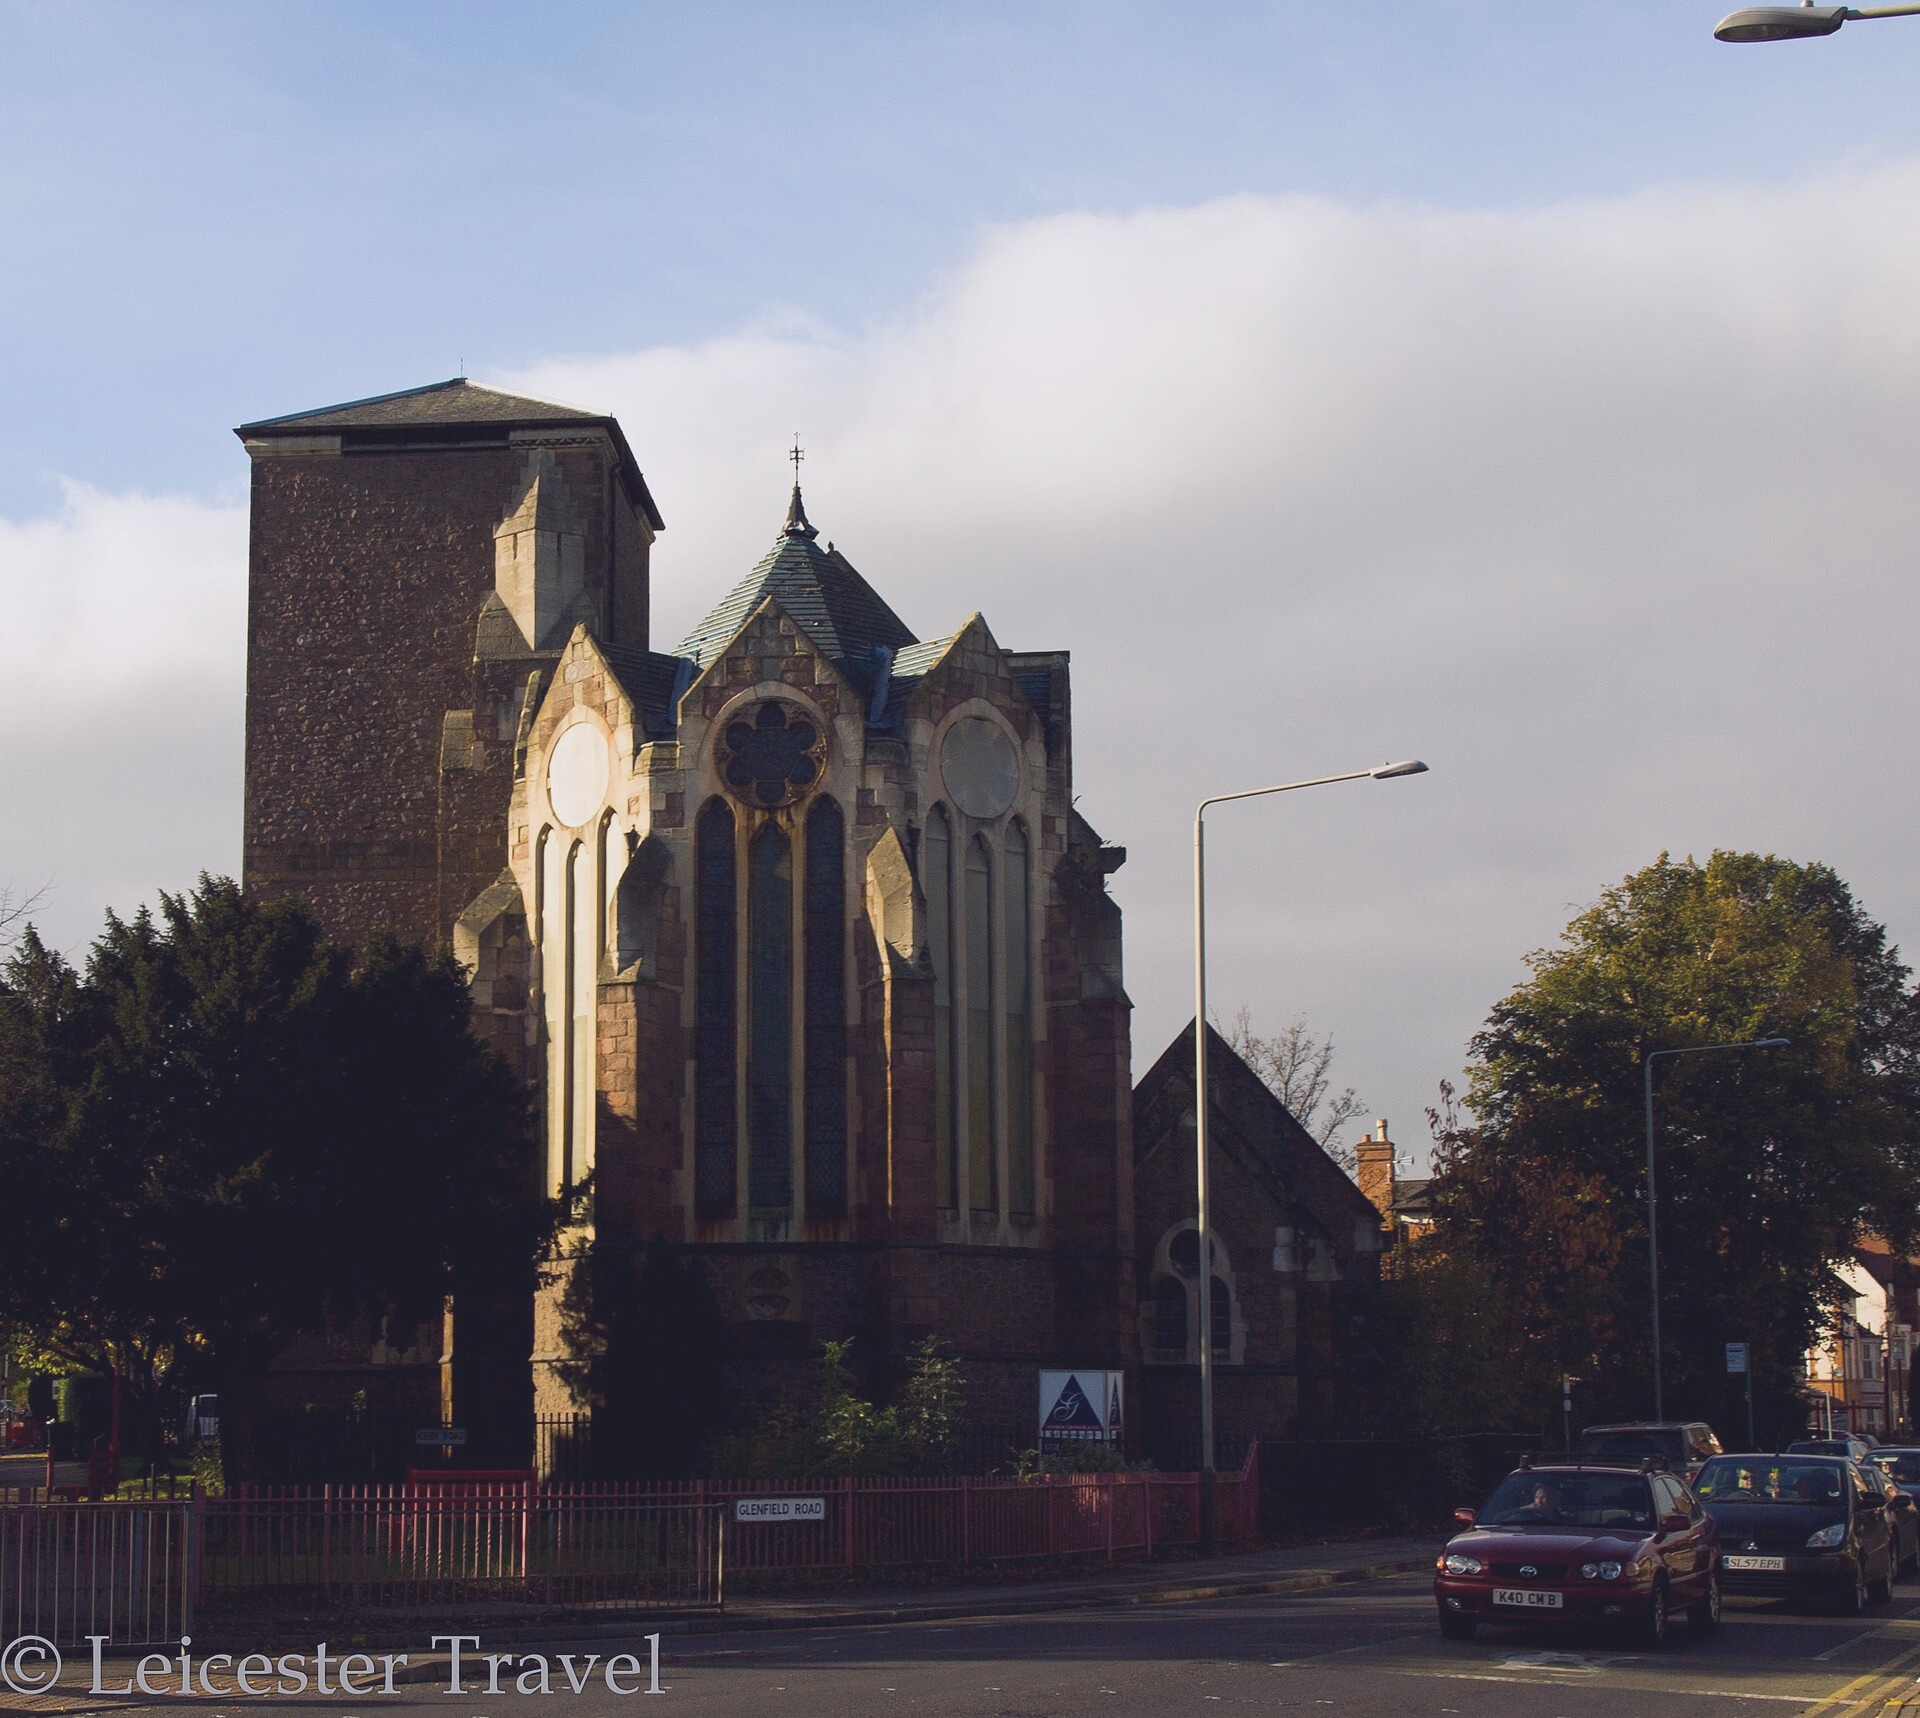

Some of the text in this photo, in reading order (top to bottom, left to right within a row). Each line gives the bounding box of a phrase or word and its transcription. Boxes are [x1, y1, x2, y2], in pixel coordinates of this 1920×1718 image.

[739, 1502, 822, 1516] GLENFIELD ROAD
[1730, 1558, 1781, 1568] SL57 EPH
[1499, 1591, 1523, 1604] K40
